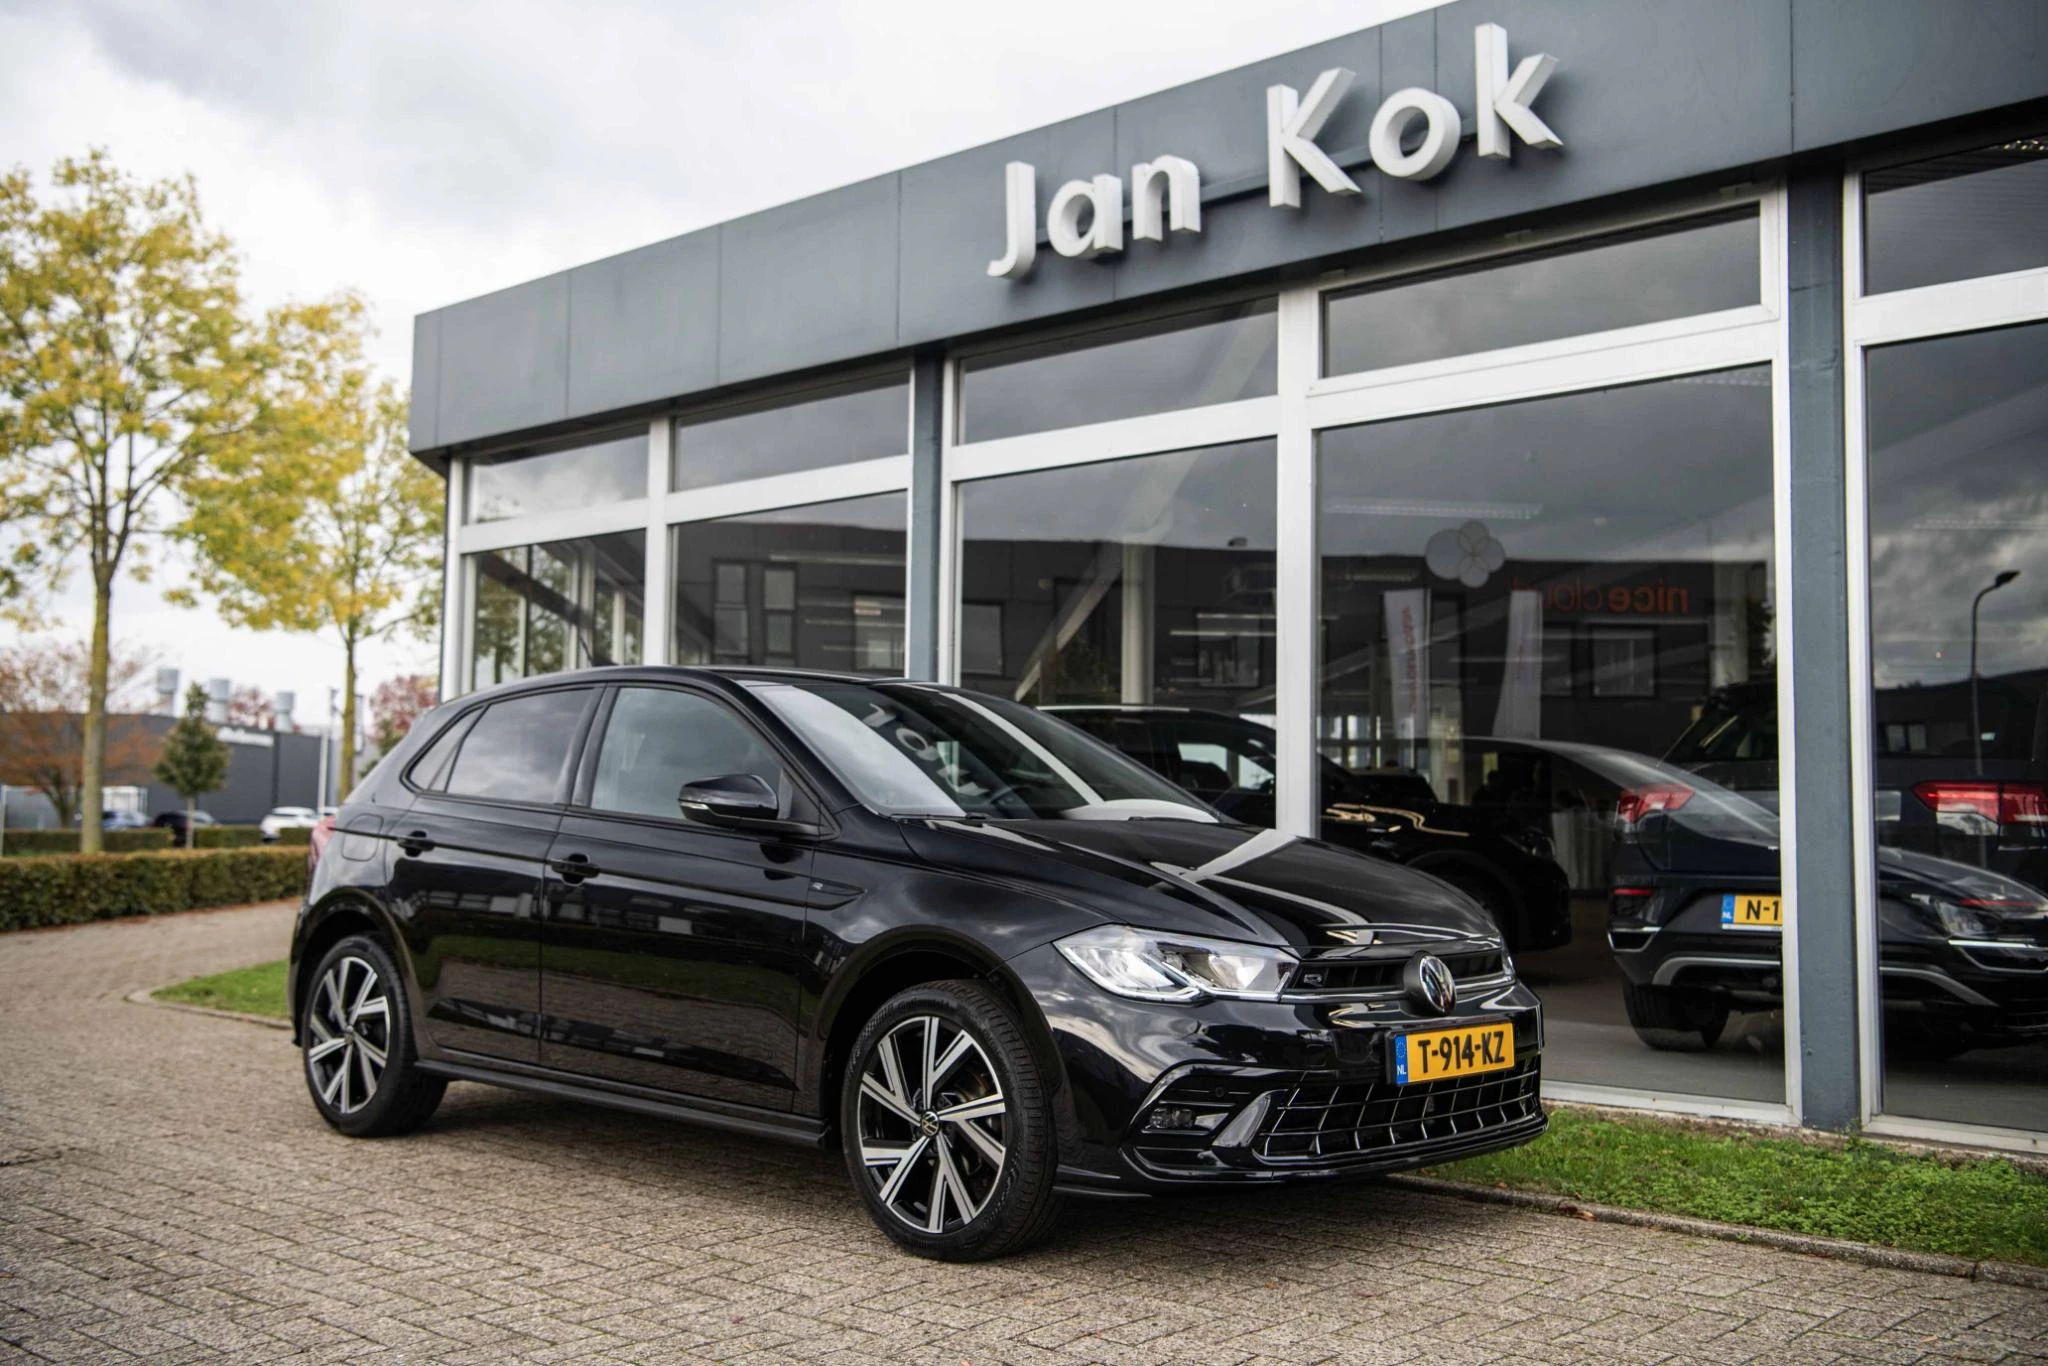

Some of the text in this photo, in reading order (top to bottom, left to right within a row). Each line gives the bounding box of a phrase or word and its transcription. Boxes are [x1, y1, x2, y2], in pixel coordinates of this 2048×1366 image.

[986, 22, 1564, 280] Jan Kok
[1746, 899, 1779, 921] N-1
[1417, 1030, 1506, 1074] T-914-KZ
[1397, 1064, 1407, 1074] NL
